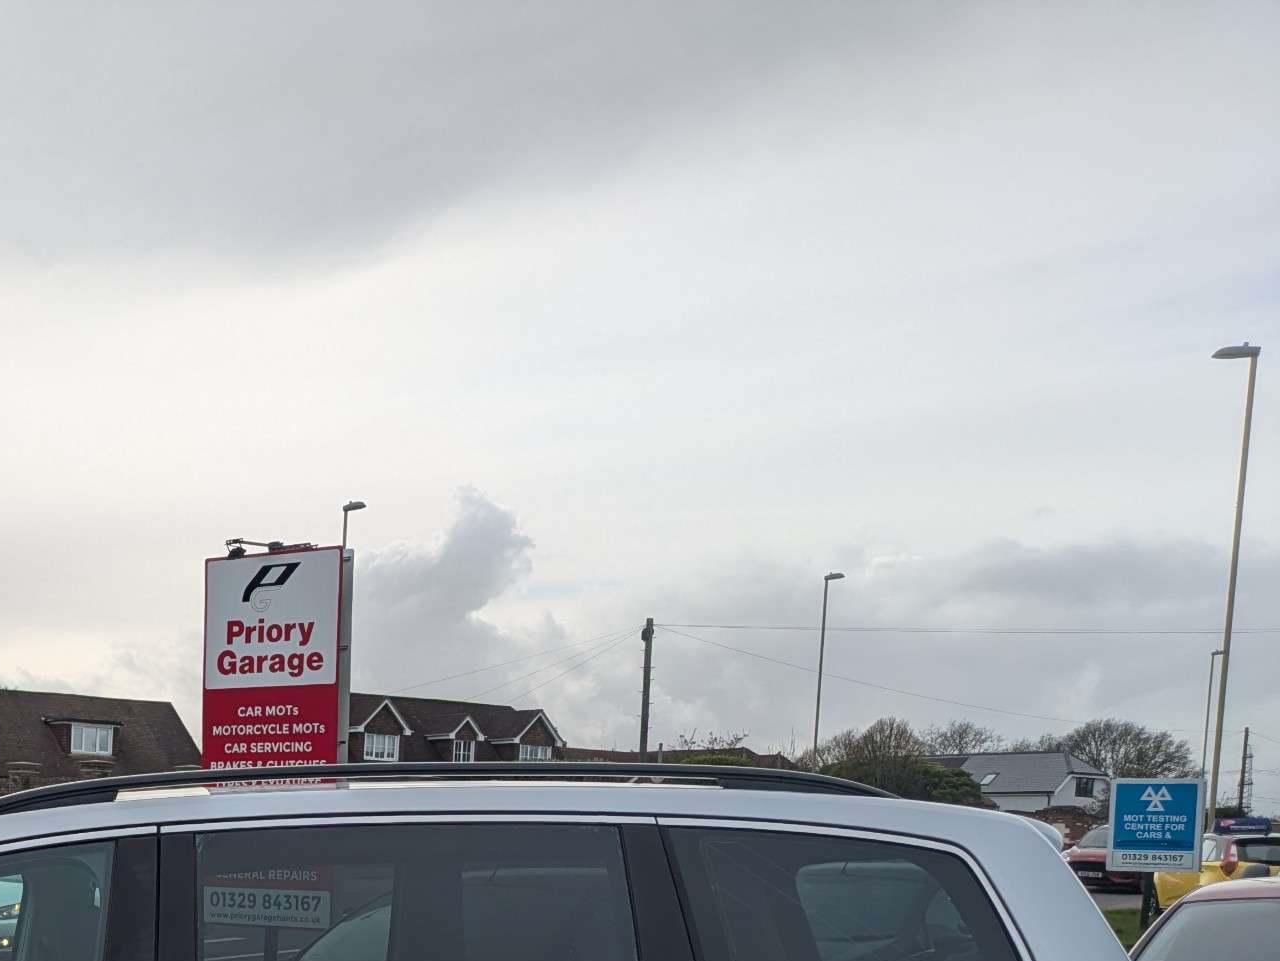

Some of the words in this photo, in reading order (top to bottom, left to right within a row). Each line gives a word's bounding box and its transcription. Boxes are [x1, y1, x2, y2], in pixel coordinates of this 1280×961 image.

[226, 618, 315, 646] Priory
[217, 650, 324, 677] Garage
[237, 706, 262, 717] CAR
[265, 705, 299, 717] MOTs
[212, 724, 289, 736] MOTORCYCLE
[292, 723, 326, 734] MOTs
[224, 743, 247, 753] CAR
[250, 741, 313, 753] SERVICING
[210, 760, 253, 770] BRAKES
[1147, 815, 1187, 823] TESTING
[1124, 822, 1163, 831] CENTRE
[1164, 823, 1185, 831] FOR
[1136, 831, 1163, 839] CARS
[1121, 853, 1149, 861] 01329
[1151, 854, 1184, 862] 843167
[268, 869, 318, 881] REPAIRS
[209, 891, 257, 909] 01329
[261, 893, 322, 912] 843167
